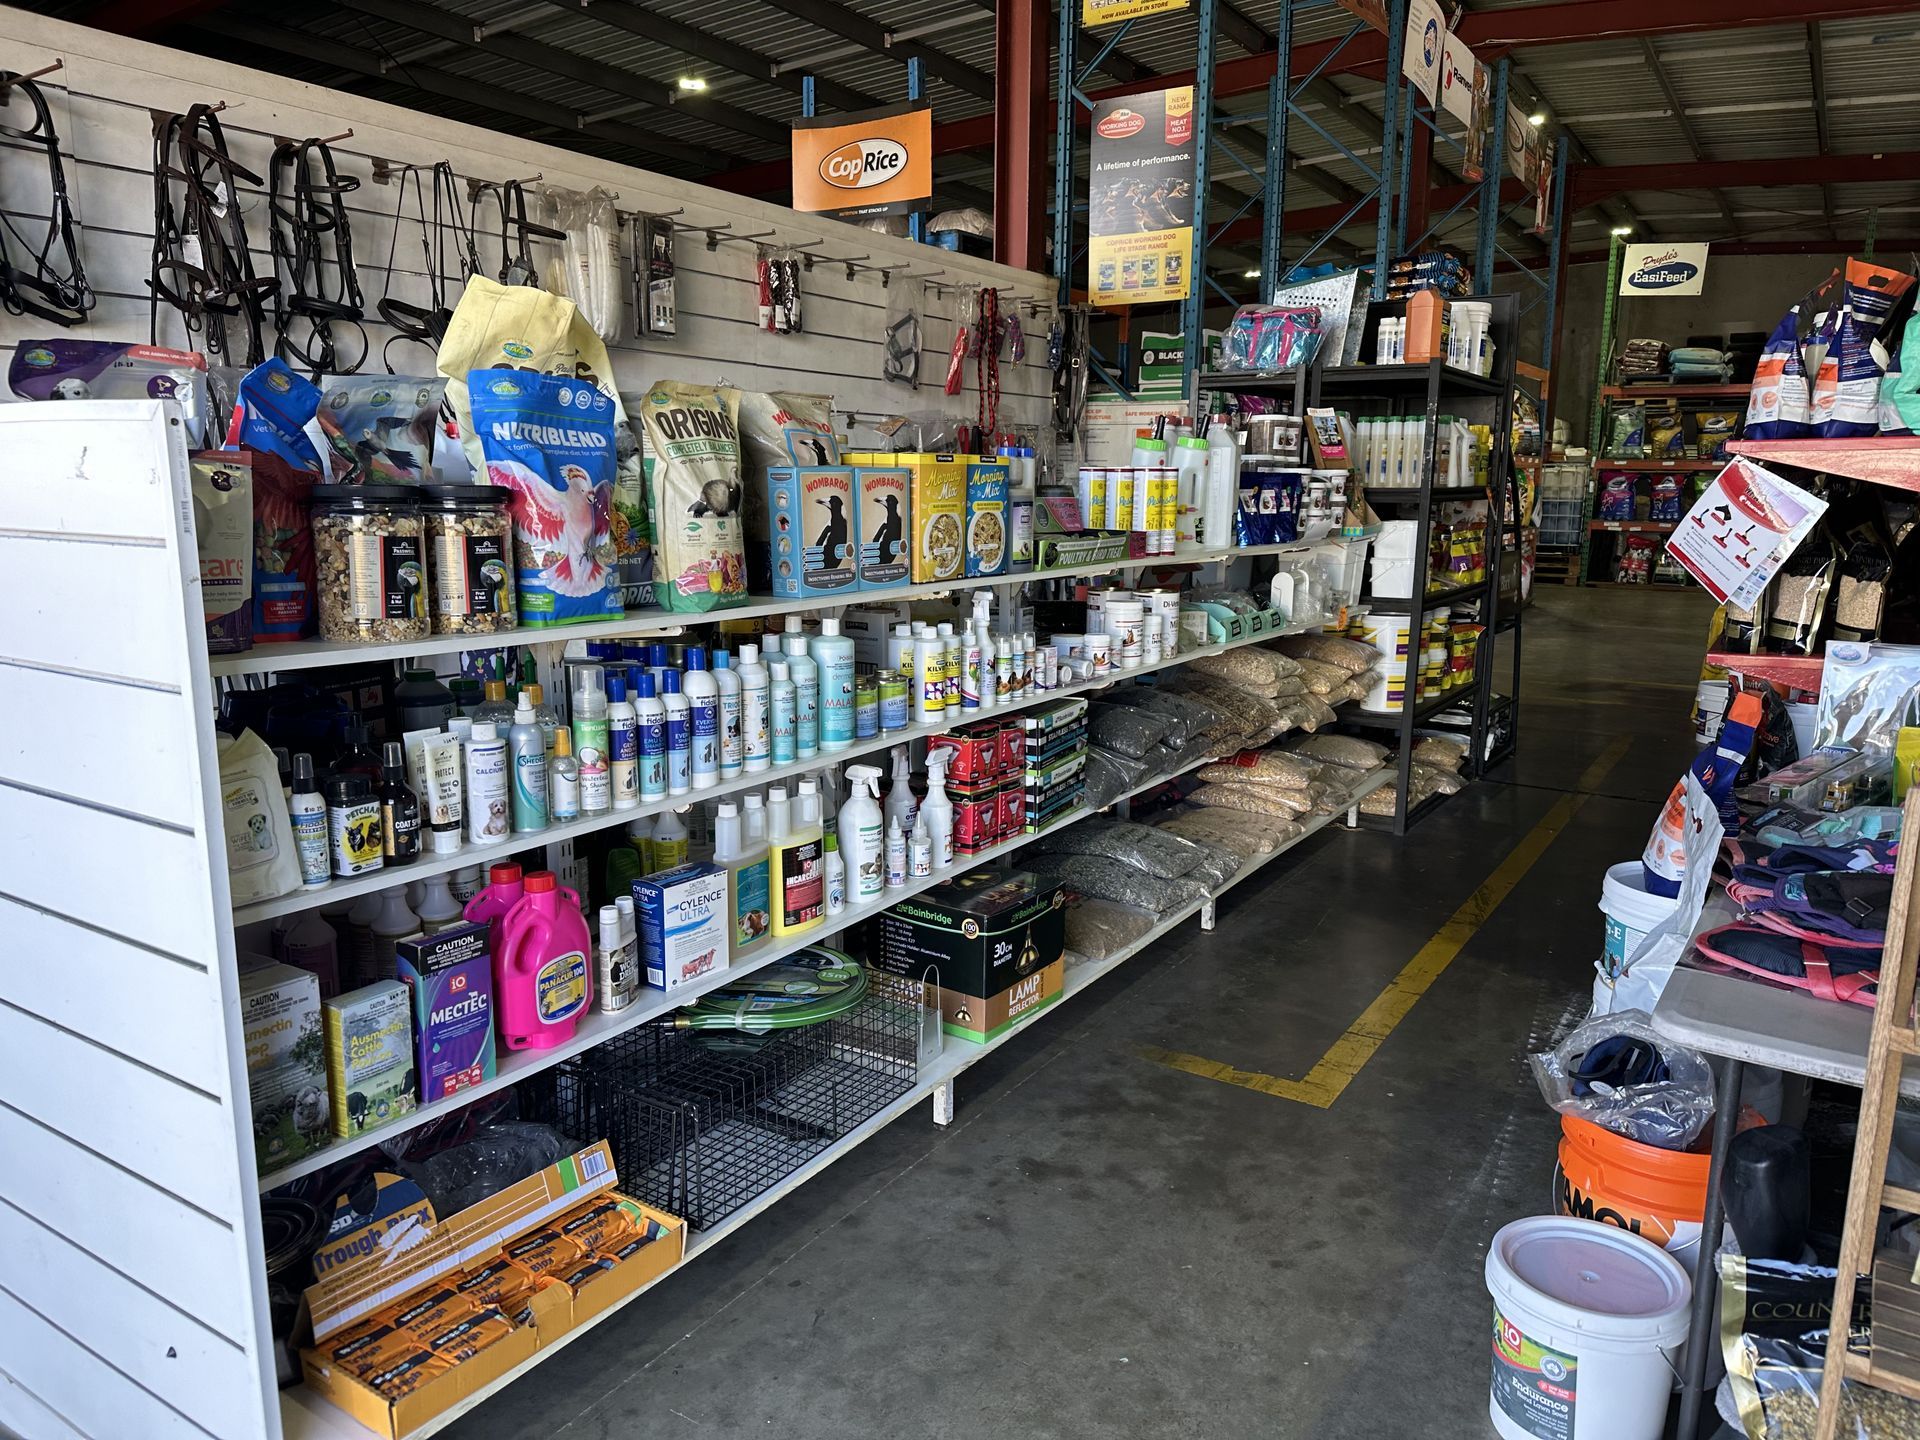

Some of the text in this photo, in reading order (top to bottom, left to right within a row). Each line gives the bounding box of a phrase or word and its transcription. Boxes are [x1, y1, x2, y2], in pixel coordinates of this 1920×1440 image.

[1102, 11, 1114, 20] NOW
[1115, 7, 1142, 17] AVAILABLE
[1151, 1, 1168, 10] STORE
[1168, 102, 1190, 110] RANGE
[1100, 121, 1128, 131] WORKING
[829, 149, 899, 181] CopRice
[1096, 152, 1191, 171] A lifetime of performance.
[1106, 237, 1132, 246] COPRICE
[1134, 235, 1162, 244] WORKING
[1128, 244, 1147, 252] STAGE
[1642, 249, 1679, 268] Pryde's
[1633, 270, 1688, 283] EasiFeed
[1158, 351, 1184, 360] BLACK
[655, 408, 736, 441] ORIGINS
[492, 422, 607, 448] NUTRIBLEND
[666, 442, 707, 456] COMPLETELY
[925, 468, 962, 487] Morning
[969, 468, 1005, 485] Morning
[938, 485, 957, 500] Mix
[981, 484, 1000, 499] Mix
[1059, 551, 1085, 565] POULTRY
[1086, 551, 1092, 561] &
[1107, 546, 1124, 559] TREAT
[434, 767, 454, 778] PROTECT
[395, 819, 411, 830] COAT
[632, 885, 656, 897] CYLENCE
[632, 893, 649, 902] ULTRA
[680, 890, 722, 911] CYLENCE
[680, 905, 710, 921] ULTRA
[908, 906, 952, 925] Bainbridge
[965, 923, 976, 931] 100
[436, 935, 474, 953] CAUTION
[993, 953, 1012, 968] DIAMETER
[540, 966, 584, 991] PANACUR 100
[250, 991, 280, 1008] CAUTION
[1009, 975, 1040, 1006] LAMP
[369, 999, 386, 1010] CAUTION
[430, 993, 488, 1026] MECTEC
[1008, 993, 1040, 1018] REFLECTOR
[351, 1021, 405, 1047] Ausmectin
[351, 1042, 384, 1058] Cattle
[314, 1228, 383, 1273] Trough
[519, 1246, 557, 1265] Trough
[406, 1307, 448, 1333] Trough
[1503, 1322, 1521, 1346] iO
[1512, 1376, 1569, 1413] Endurance
[1516, 1390, 1532, 1405] Blend
[1533, 1400, 1551, 1414] Lawn
[1551, 1409, 1569, 1420] Seed
